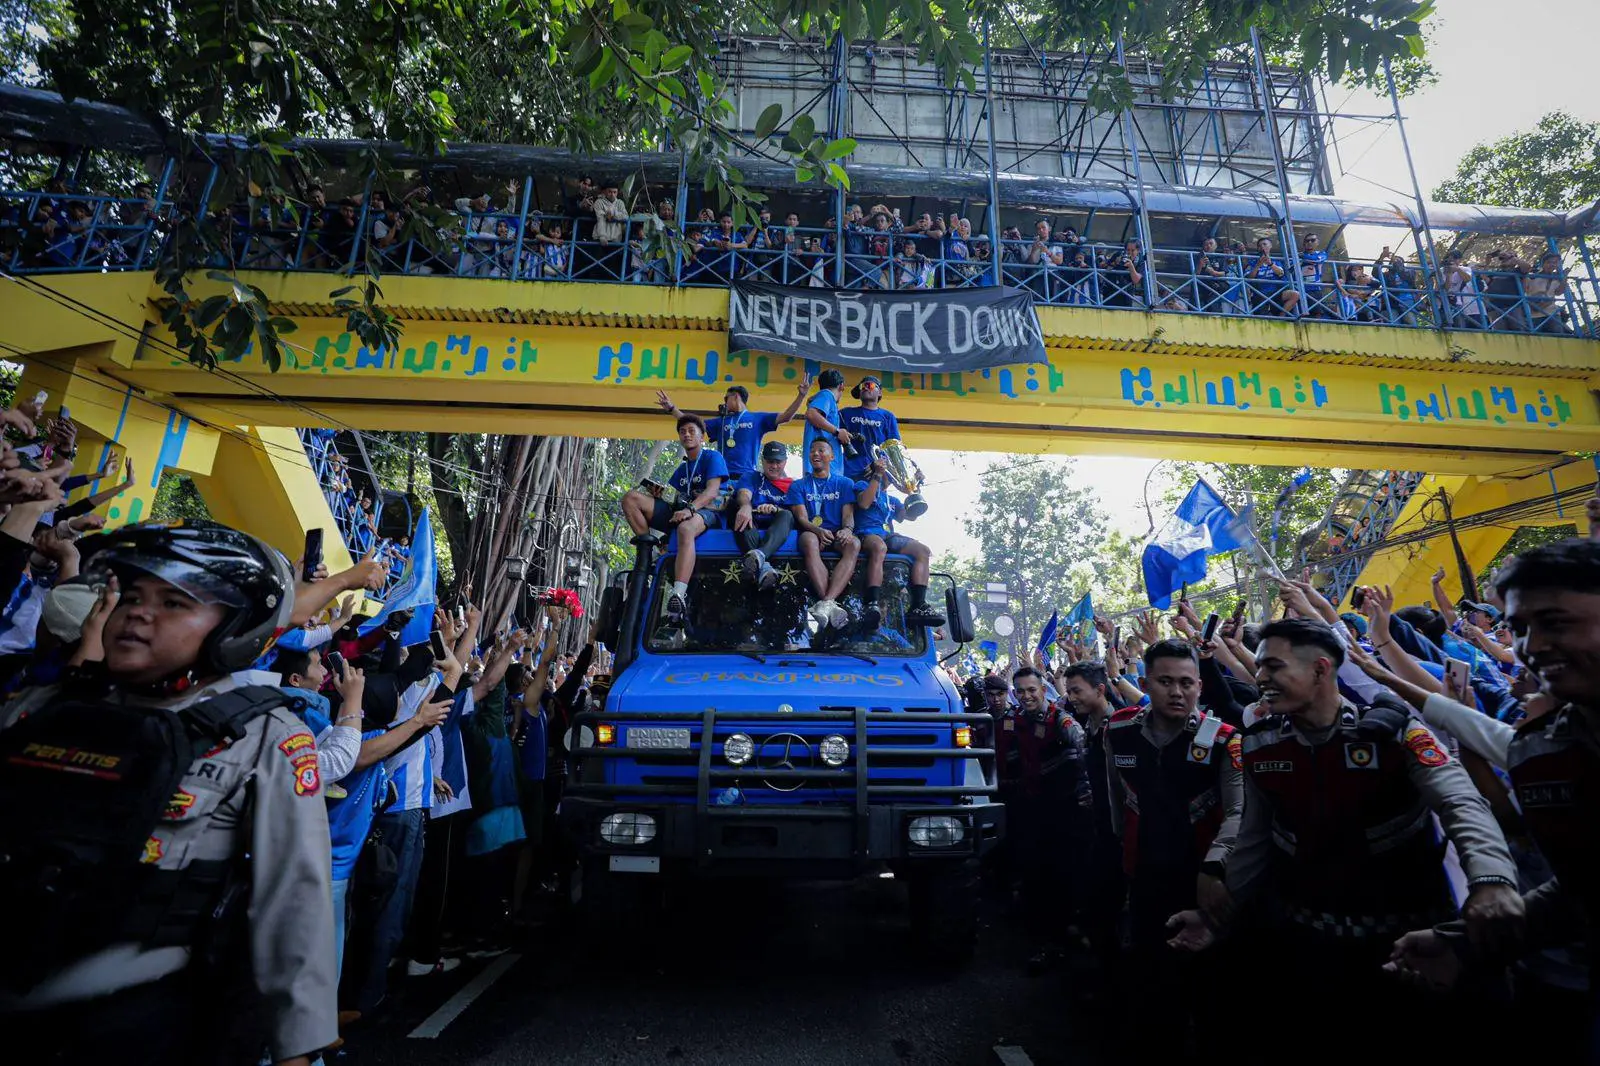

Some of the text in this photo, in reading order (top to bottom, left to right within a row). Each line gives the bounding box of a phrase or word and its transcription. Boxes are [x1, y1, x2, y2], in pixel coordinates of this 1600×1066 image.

[730, 290, 1045, 355] NEVER BACK DOWN
[665, 672, 904, 687] CHAMPIONS
[629, 728, 690, 738] UNIMOG
